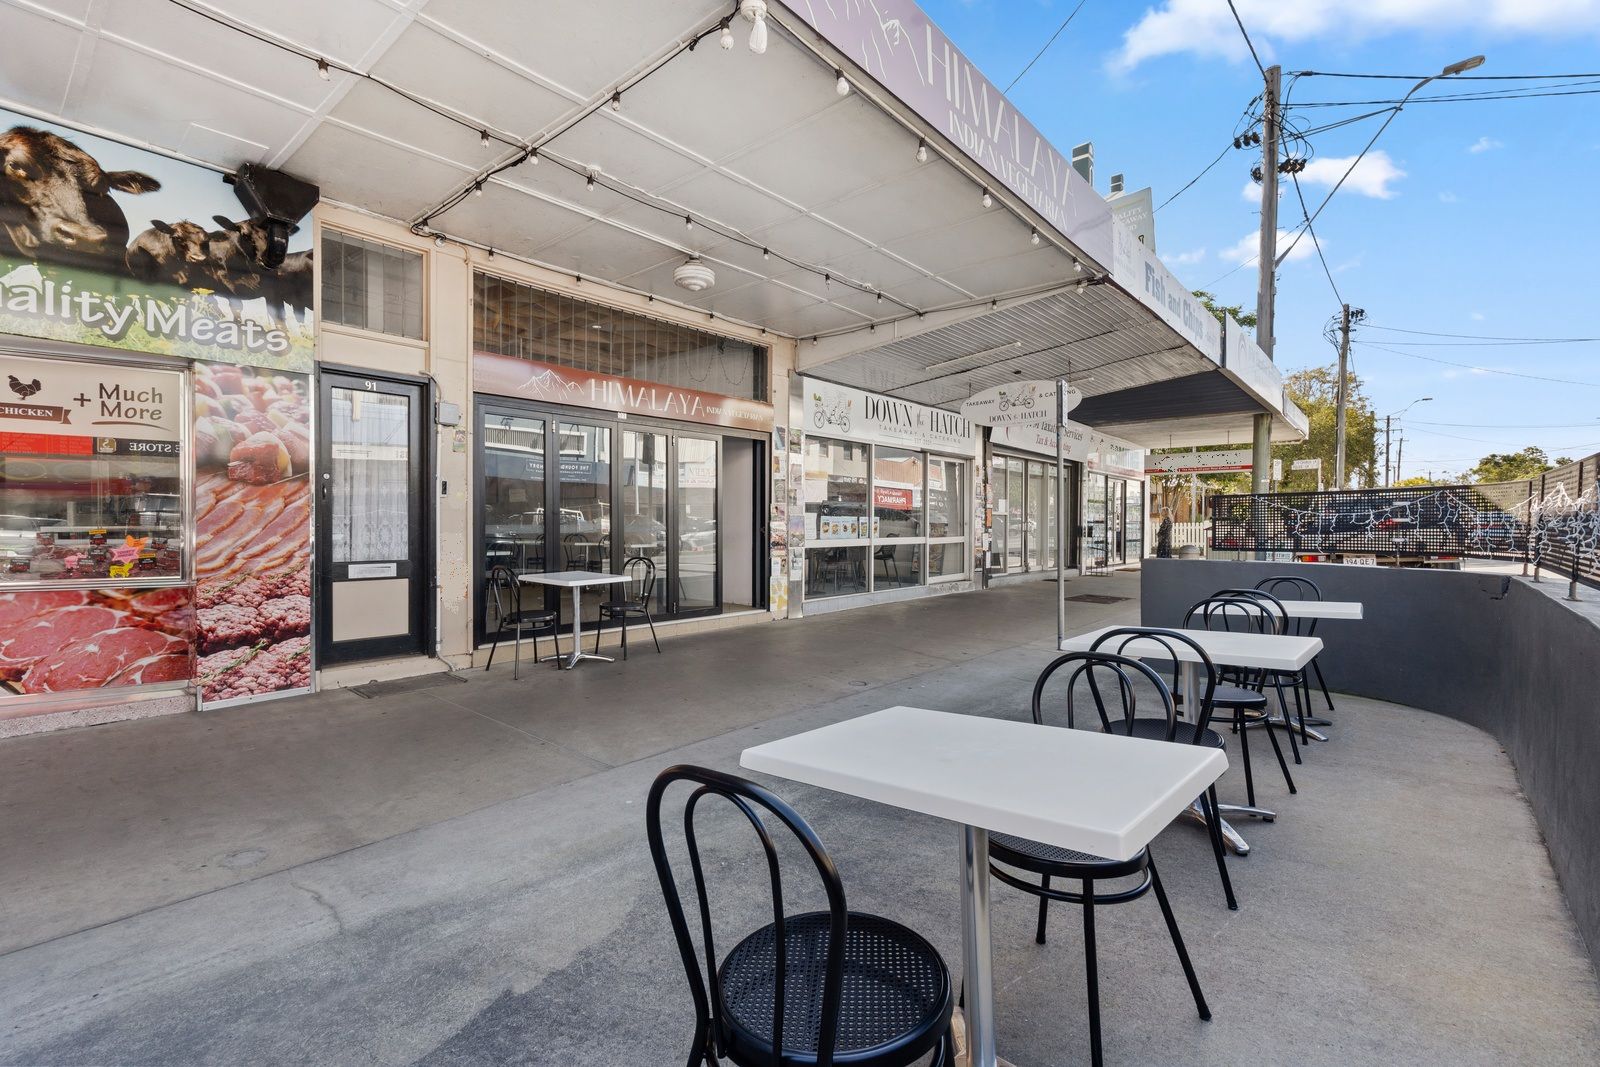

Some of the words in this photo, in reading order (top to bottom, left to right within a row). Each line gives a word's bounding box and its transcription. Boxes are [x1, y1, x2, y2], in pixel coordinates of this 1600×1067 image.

[926, 23, 1077, 217] HIMALAYA
[949, 110, 1000, 173] INDIAN
[1000, 154, 1068, 231] VEGETARIAN
[1145, 261, 1165, 307] Fish
[1168, 293, 1181, 319] and
[1183, 299, 1204, 342] Chips
[146, 299, 289, 352] Meats
[99, 383, 163, 404] Much
[365, 381, 377, 391] 91
[591, 378, 705, 417] HIMALAYA
[966, 399, 995, 407] TAKEAWAY
[1044, 388, 1076, 398] CATNG
[100, 400, 162, 420] More
[865, 395, 913, 427] DOWN
[930, 411, 970, 438] HATCH
[989, 414, 1012, 423] DOWN
[1021, 410, 1047, 420] HATCH
[879, 424, 918, 436] TAKEAWAY
